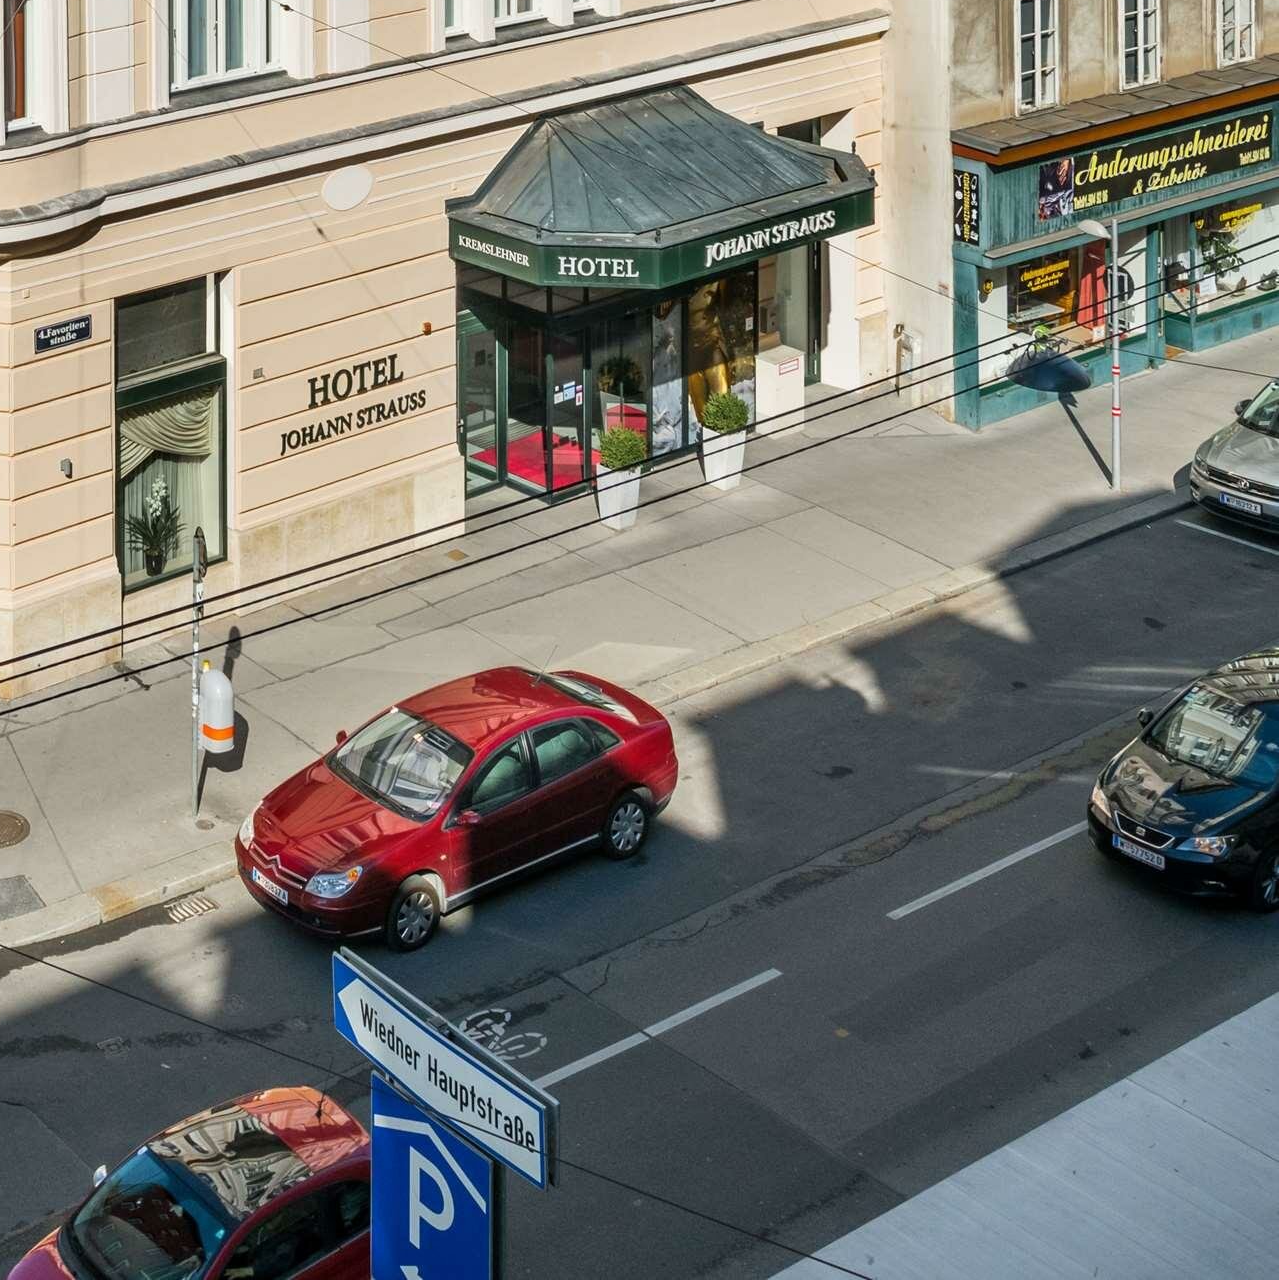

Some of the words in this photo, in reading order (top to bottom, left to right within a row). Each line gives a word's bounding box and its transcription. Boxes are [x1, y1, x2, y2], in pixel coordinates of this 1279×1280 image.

[1074, 114, 1270, 186] Änderungsschneiderei
[1132, 178, 1144, 196] &
[1145, 162, 1208, 193] Zubehör
[458, 234, 530, 268] KREMSLEHNER
[557, 256, 640, 278] HOTEL
[704, 228, 770, 268] JOHANN
[771, 210, 836, 245] STRAUSS
[50, 332, 77, 346] straße
[307, 353, 404, 410] HOTEL
[280, 412, 353, 456] JOHANN
[356, 389, 427, 429] STRAUSS
[359, 997, 422, 1072] Wiedner
[427, 1052, 536, 1154] Hauptstraße
[409, 1144, 456, 1250] P
